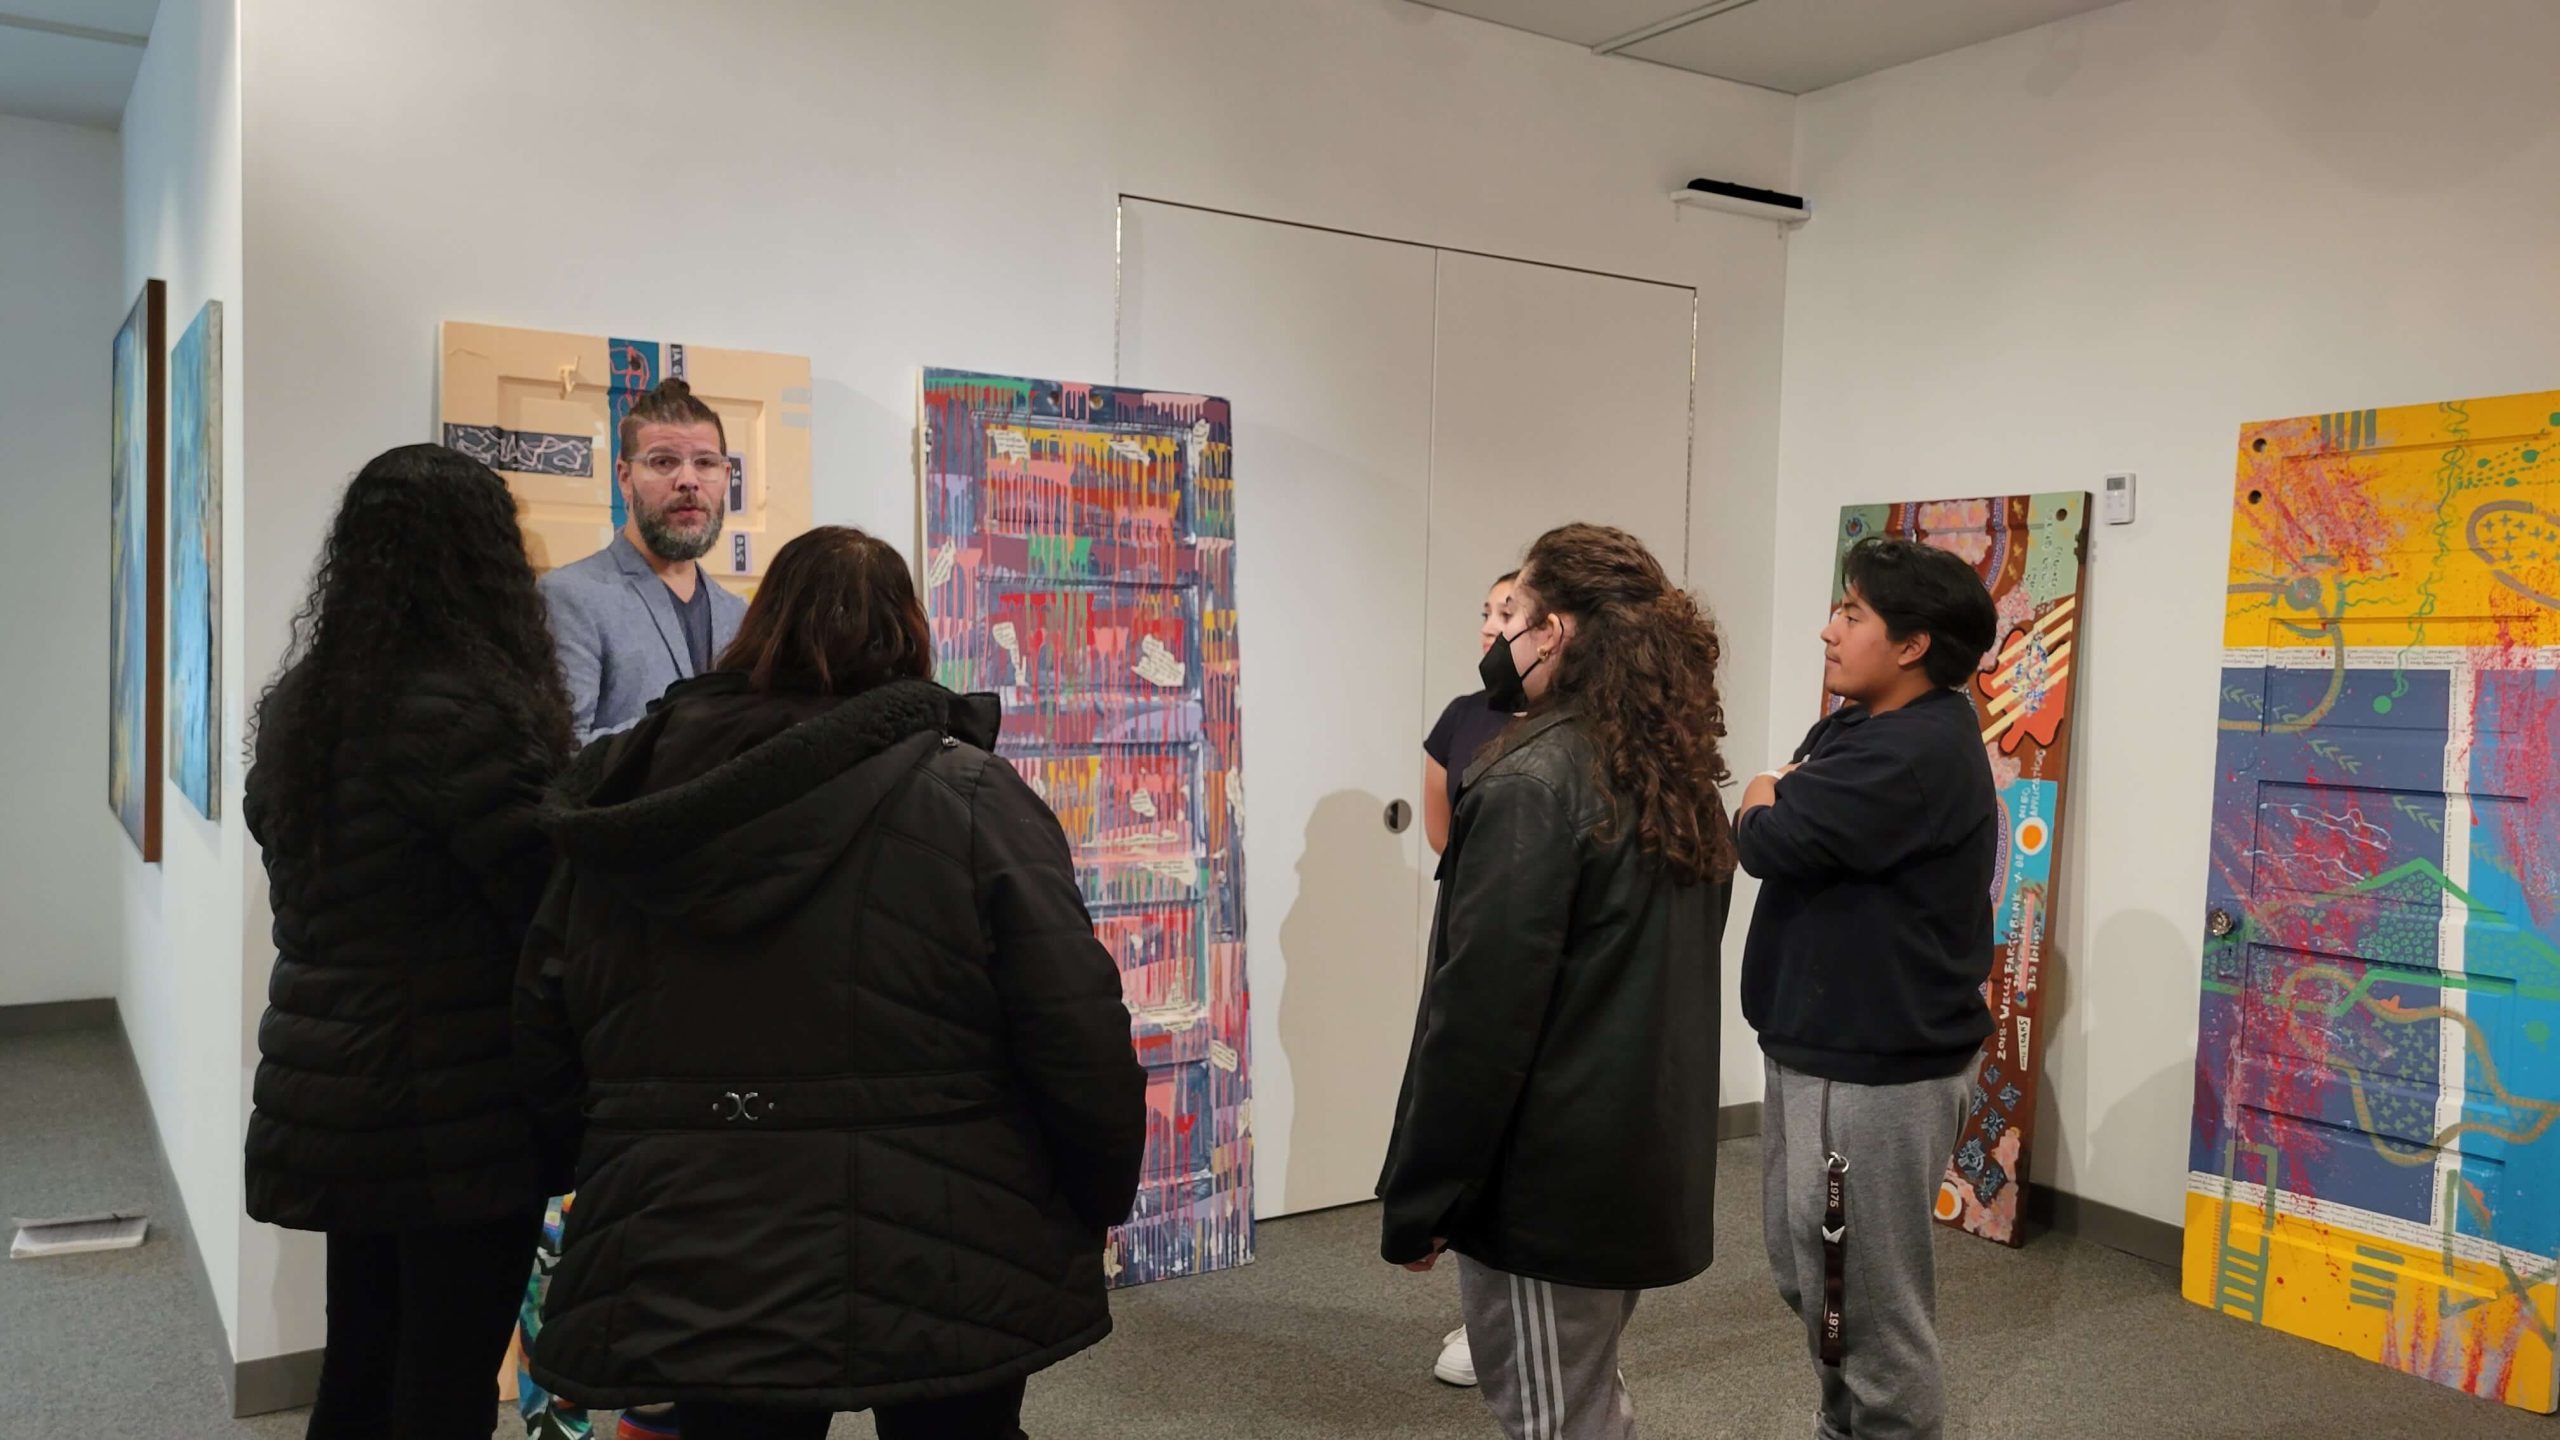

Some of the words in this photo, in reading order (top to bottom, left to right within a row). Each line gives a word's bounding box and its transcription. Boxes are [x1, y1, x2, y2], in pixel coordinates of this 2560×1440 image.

[2009, 893, 2023, 928] BANK
[2004, 931, 2019, 974] FARGO
[1999, 977, 2012, 1019] WELLS
[1829, 1180, 1839, 1208] 1975
[1828, 1311, 1840, 1339] 1975
